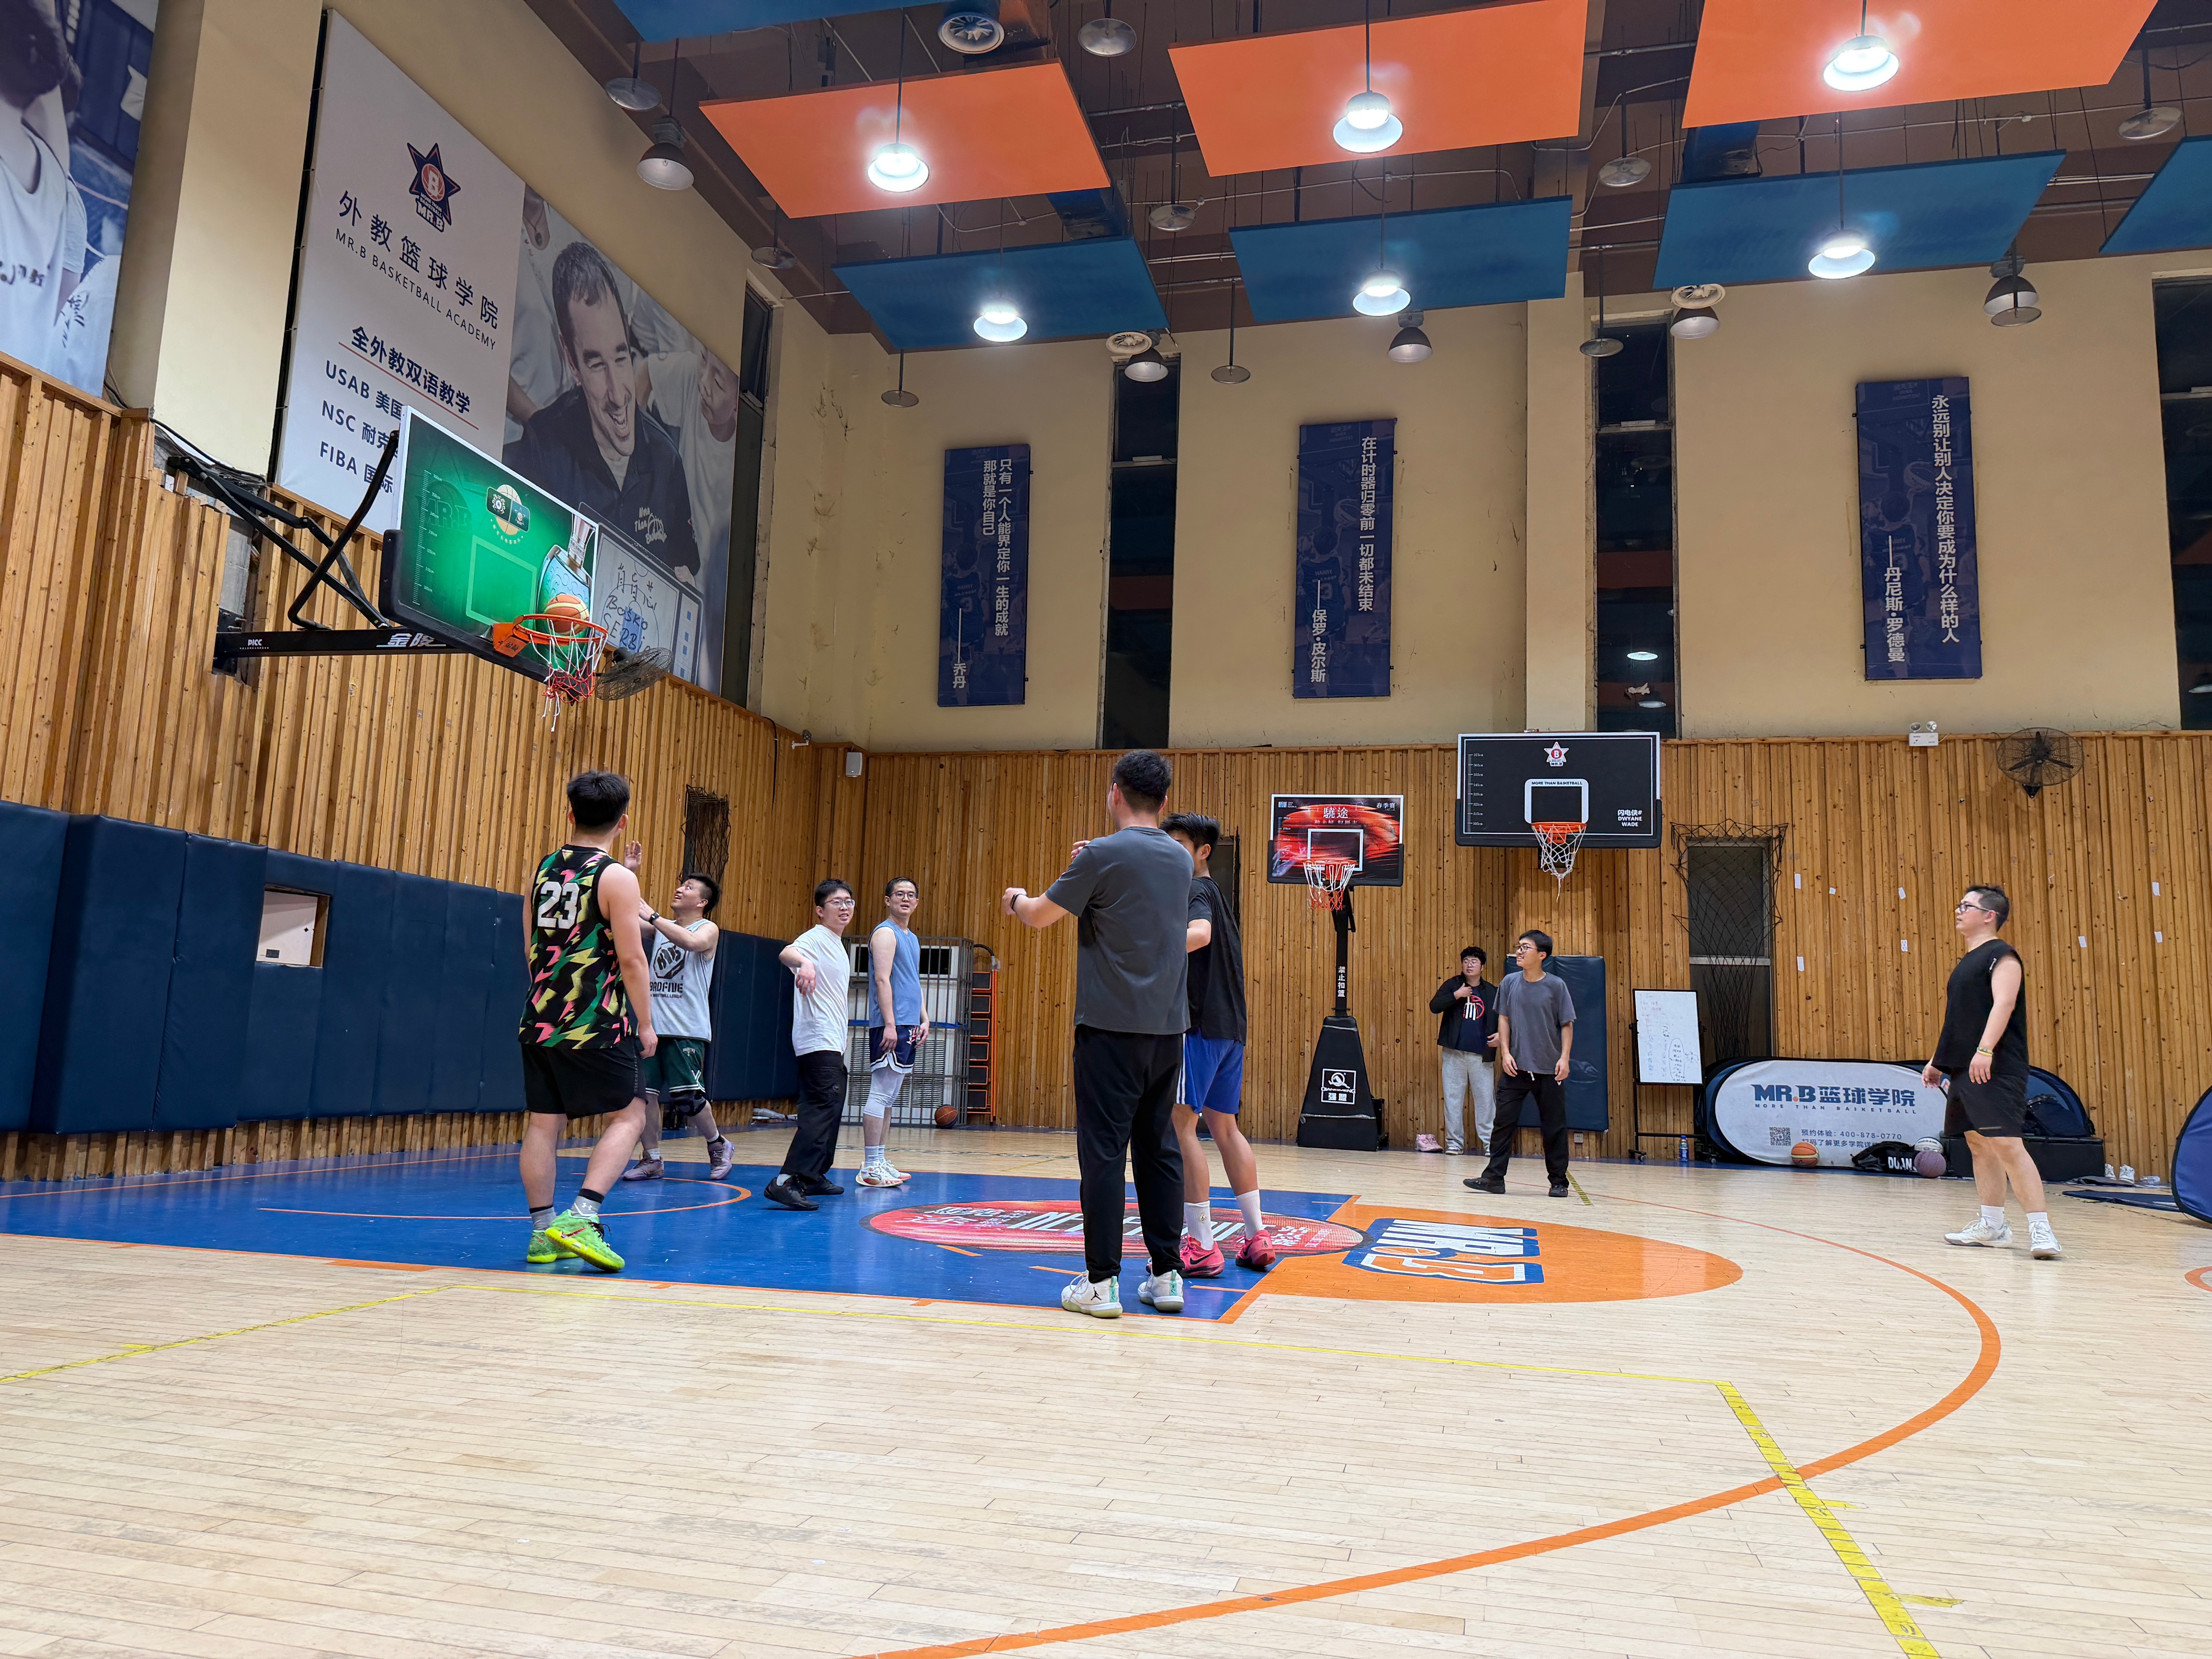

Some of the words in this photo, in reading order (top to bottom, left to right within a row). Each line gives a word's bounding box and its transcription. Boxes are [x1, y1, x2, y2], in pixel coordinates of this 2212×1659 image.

[417, 201, 444, 231] MR.B
[432, 201, 442, 212] THAN
[336, 229, 366, 258] MR.B
[373, 254, 441, 313] BASKETBALL
[446, 309, 495, 350] ACADEMY
[339, 190, 498, 329] 外教篮球学院
[326, 360, 369, 399] USAB
[352, 326, 470, 413] 全外教双语教学
[322, 400, 356, 432] NSC
[320, 441, 358, 475] FIBA
[982, 460, 997, 535] 那就是你自己
[1358, 436, 1376, 611] 在计时器归零前一切都未结束
[1932, 395, 1960, 643] 永远别让别人决定你要成为什么样的人
[995, 459, 1012, 636] 只有一个人能界定你一生的成就
[376, 633, 446, 647] 金陵
[538, 881, 579, 929] 23
